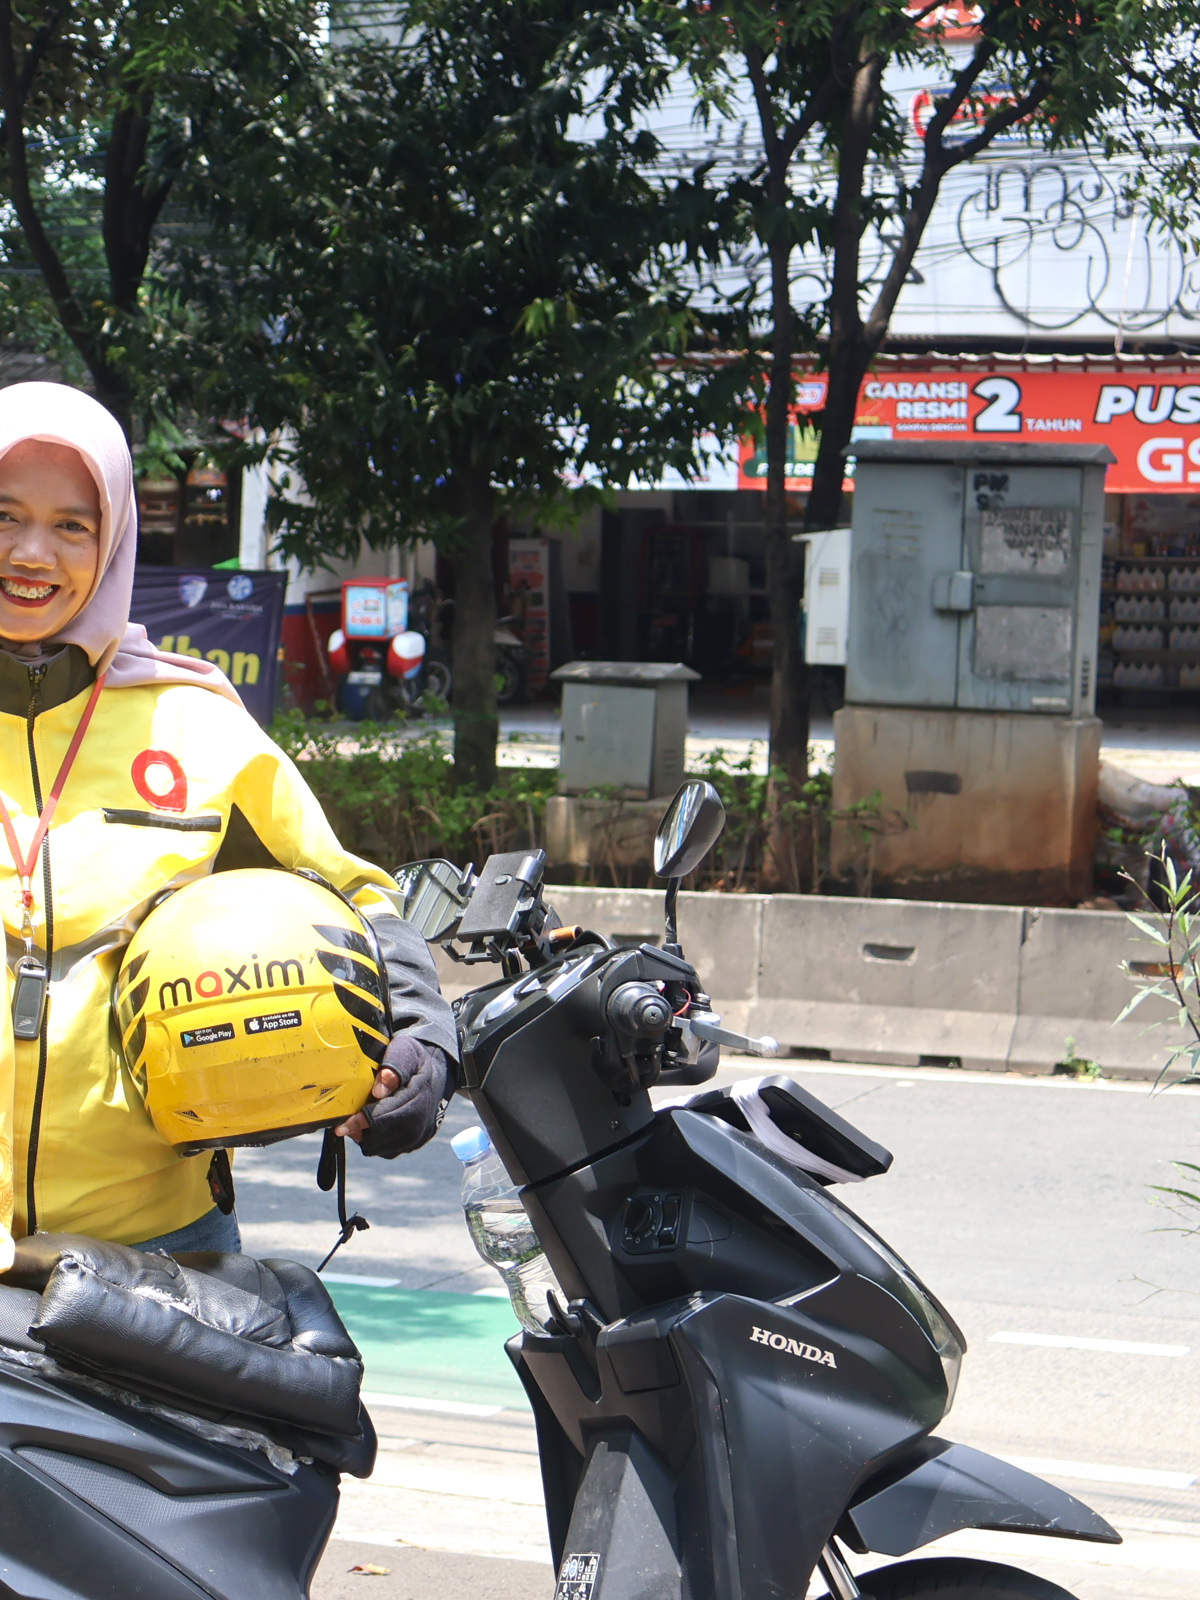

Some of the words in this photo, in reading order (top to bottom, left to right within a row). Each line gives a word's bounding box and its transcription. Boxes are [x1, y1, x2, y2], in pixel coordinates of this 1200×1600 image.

[865, 382, 968, 399] GARANSI
[896, 401, 968, 419] RESMI
[973, 376, 1022, 432] 2
[1025, 418, 1082, 432] TAHUN
[158, 953, 305, 1011] maxim
[263, 1020, 278, 1029] App
[279, 1017, 299, 1027] Store
[196, 1031, 218, 1043] Google
[218, 1030, 232, 1038] Play
[749, 1326, 838, 1369] HONDA
